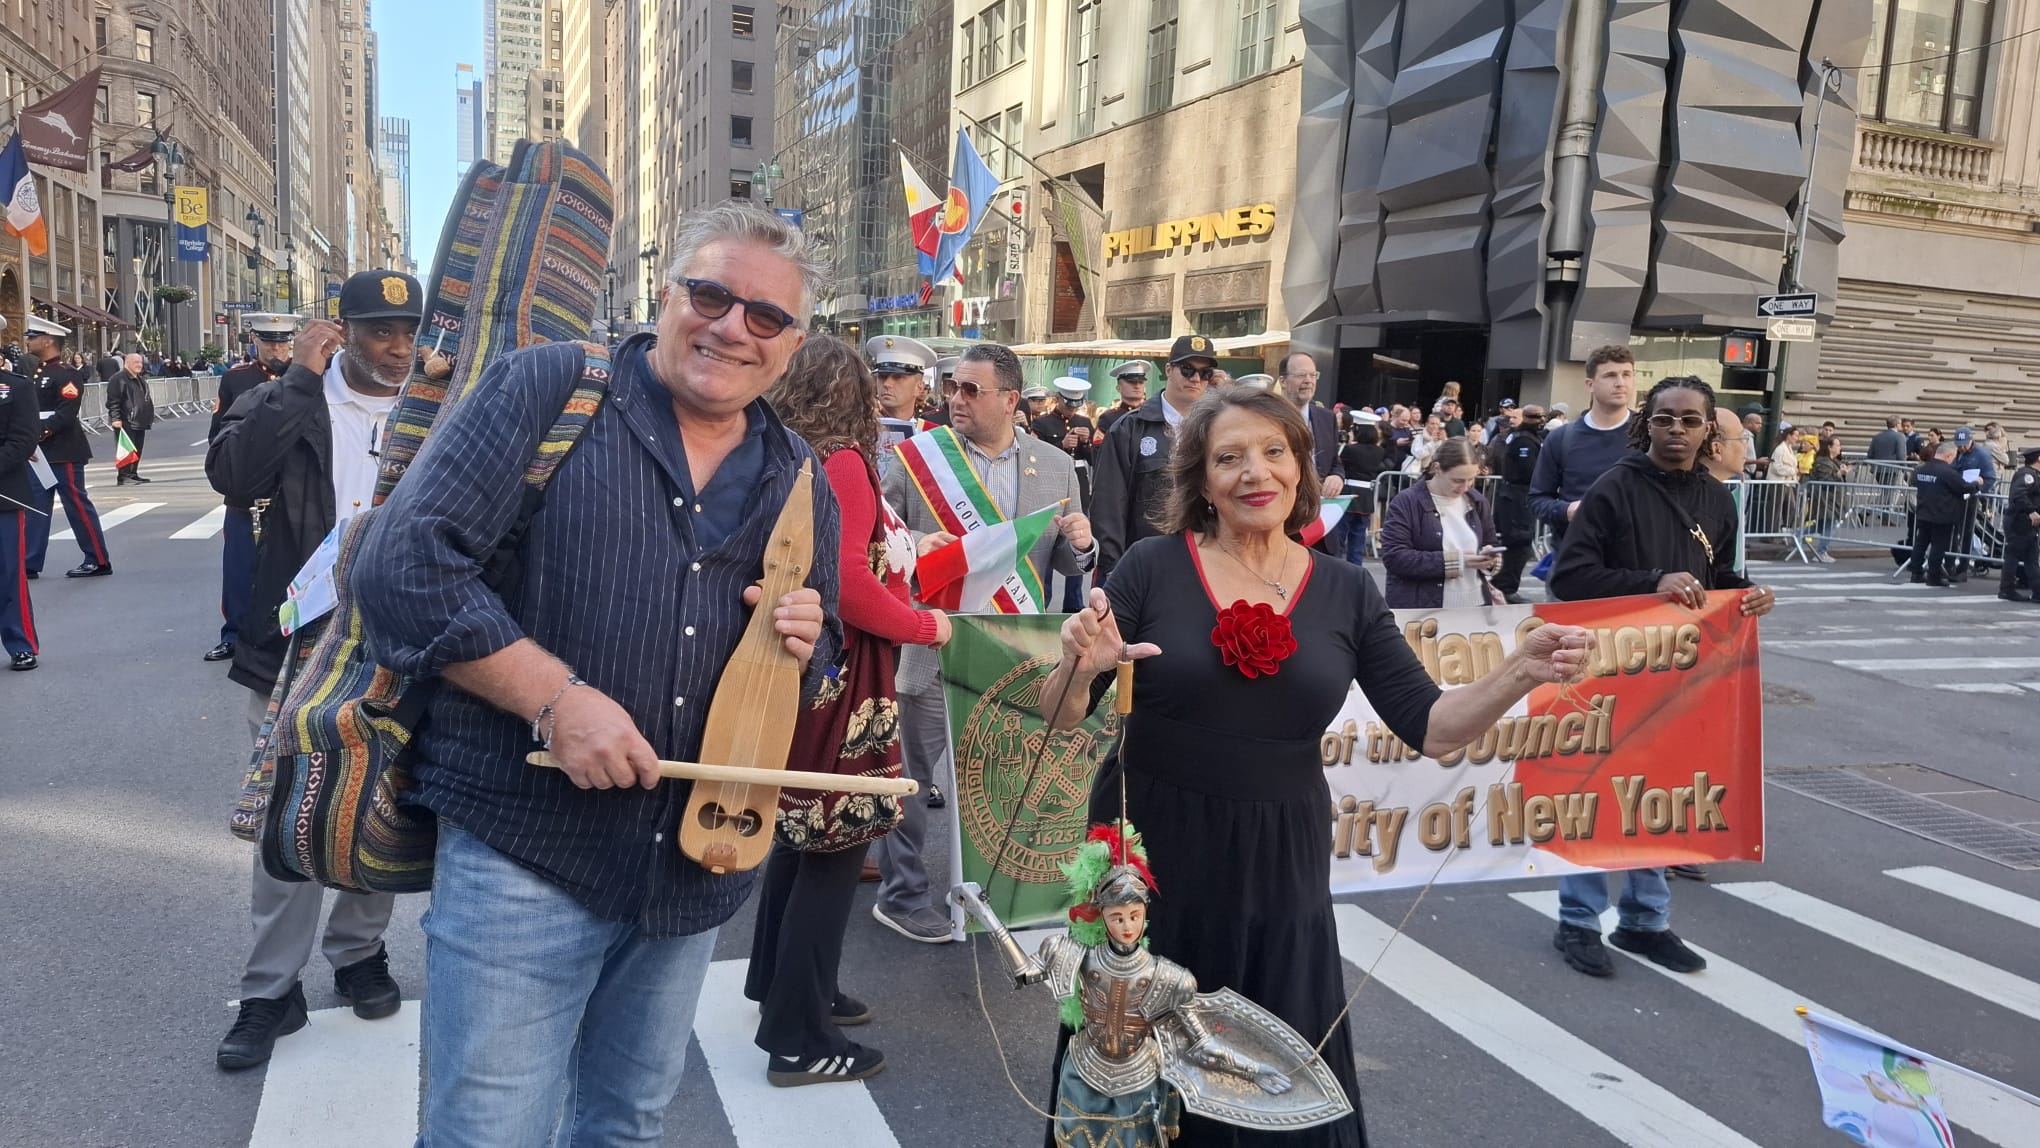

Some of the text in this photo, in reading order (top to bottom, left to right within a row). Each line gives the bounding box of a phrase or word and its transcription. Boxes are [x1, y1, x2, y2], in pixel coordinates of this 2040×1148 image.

[21, 139, 50, 156] Tommy
[31, 152, 49, 161] NEW
[180, 197, 203, 215] Be
[1103, 203, 1277, 260] PHILIPPINES
[1010, 243, 1020, 270] GIFTS
[1768, 300, 1810, 311] ONE WAY
[1777, 325, 1809, 334] ONE WAY
[1743, 341, 1754, 363] 5
[1917, 473, 1937, 484] SECURITY
[1320, 718, 1357, 766] of
[1331, 771, 1729, 875] ity of New York
[1035, 829, 1077, 846] 1625
